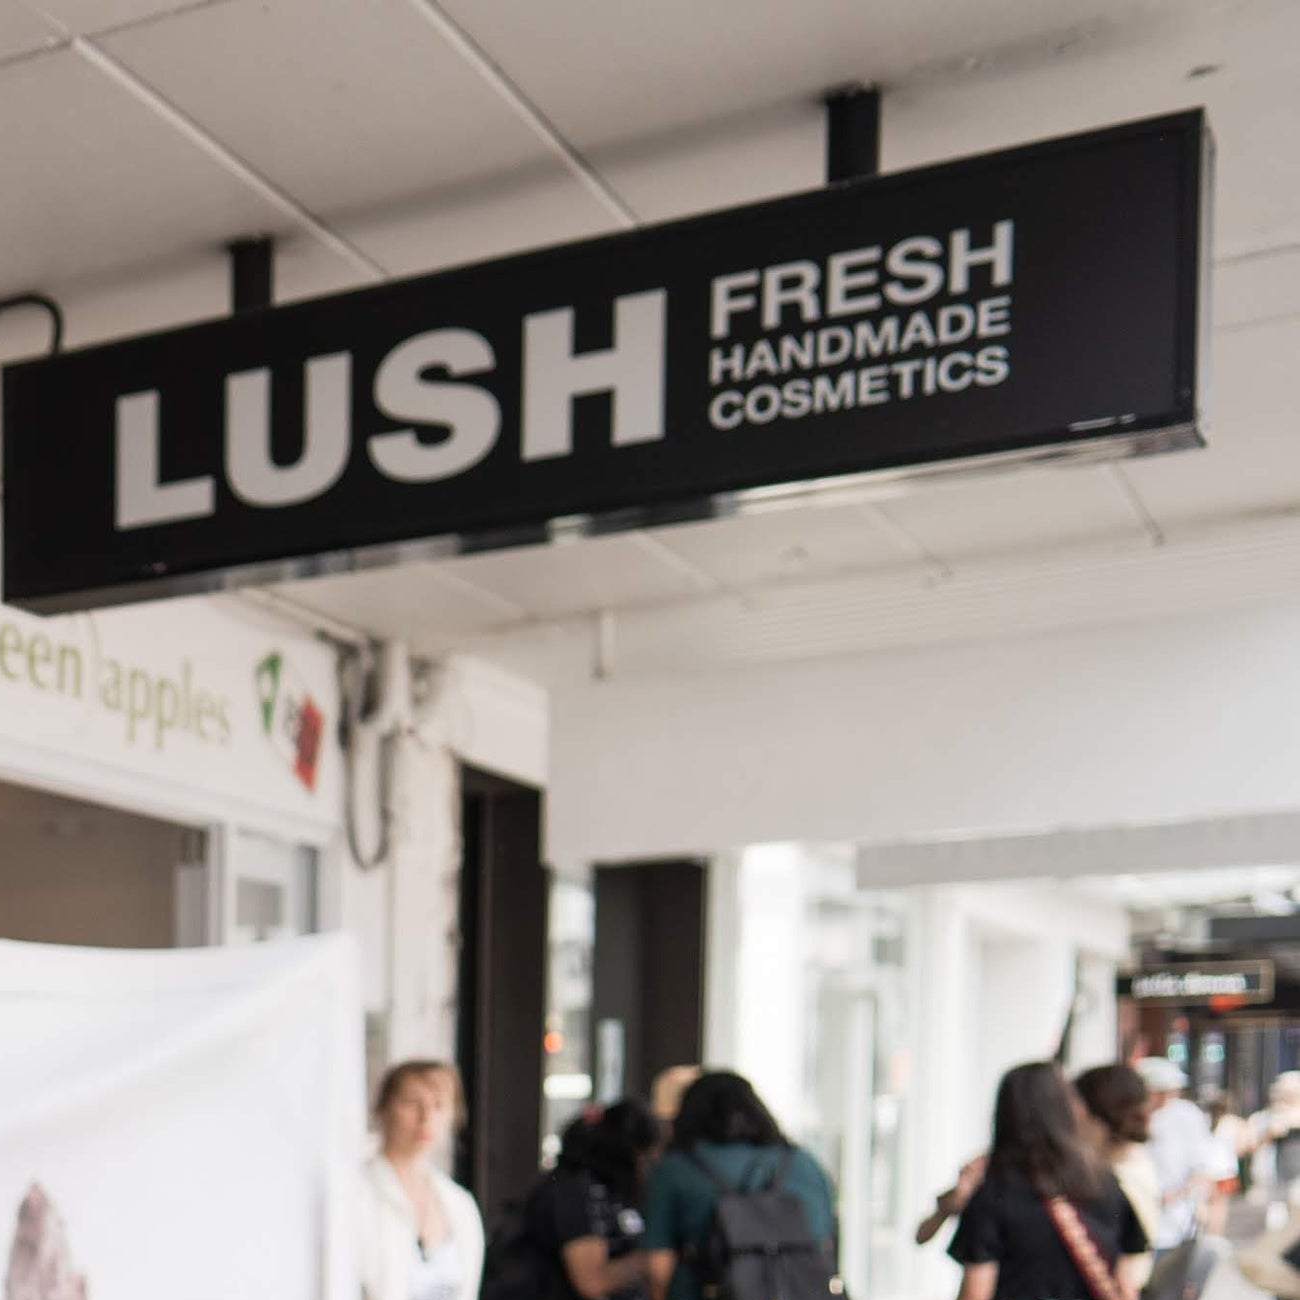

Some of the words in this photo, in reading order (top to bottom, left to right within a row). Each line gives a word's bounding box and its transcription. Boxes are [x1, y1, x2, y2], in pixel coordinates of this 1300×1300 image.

[710, 221, 1014, 339] FRESH
[710, 296, 1011, 386] HANDMADE
[710, 345, 1010, 430] COSMETICS
[115, 290, 668, 530] LUSH
[102, 656, 232, 750] apples
